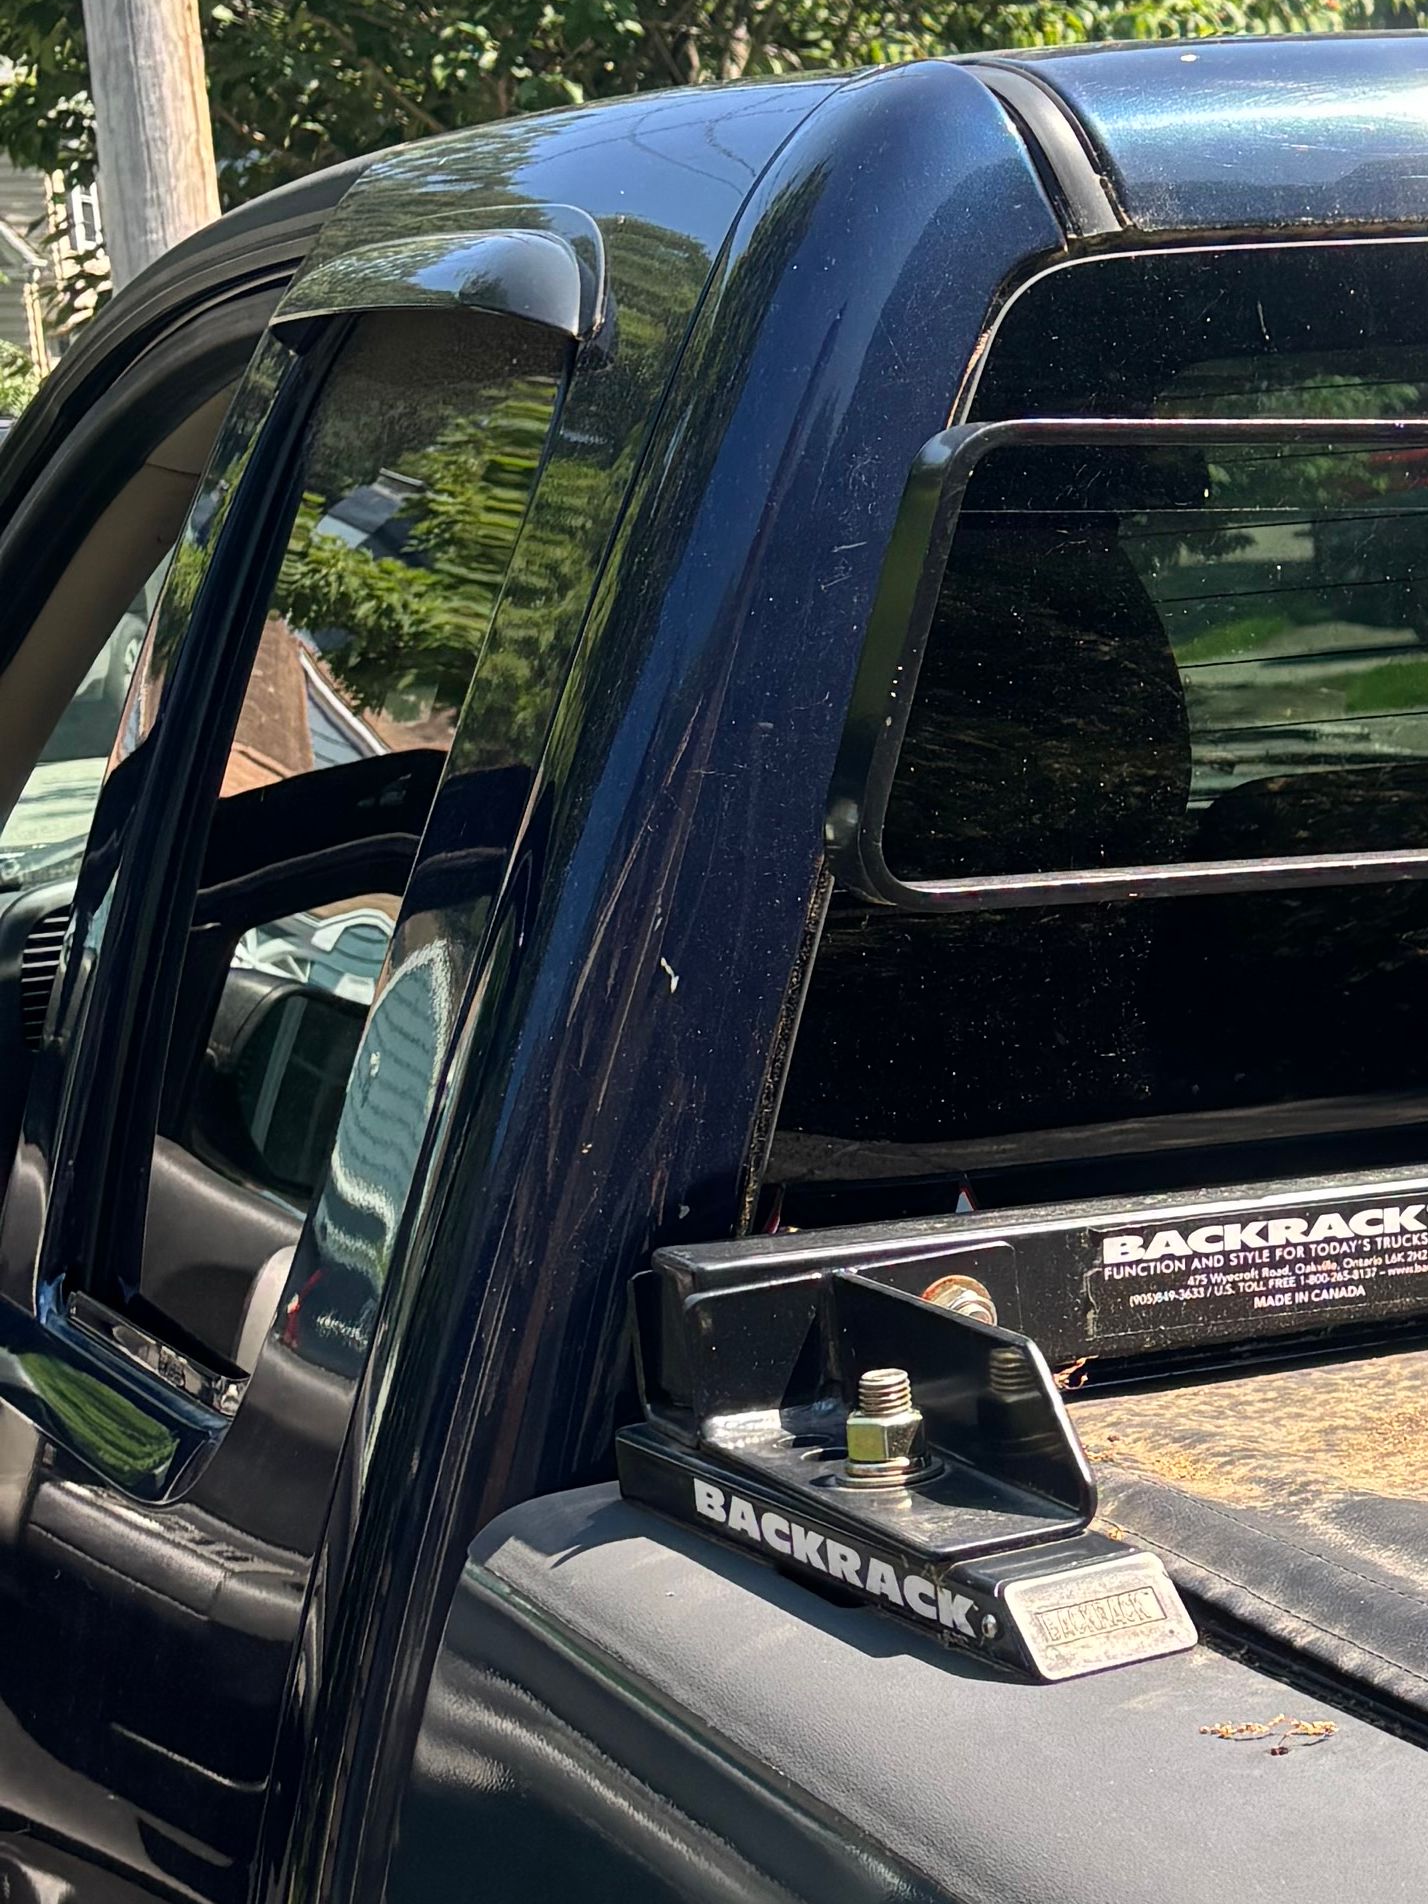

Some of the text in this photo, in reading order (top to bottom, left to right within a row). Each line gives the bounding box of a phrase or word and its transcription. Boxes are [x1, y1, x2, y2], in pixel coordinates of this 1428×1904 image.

[1102, 1203, 1428, 1265] BACKRACK
[1104, 1232, 1428, 1281] FUNCTION AND STYLE FOR TODAY'S TRUCKS
[1187, 1274, 1208, 1287] 475
[1343, 1255, 1383, 1269] Ontario
[1214, 1285, 1236, 1296] U.S.
[1237, 1281, 1267, 1294] TOLL
[1268, 1276, 1297, 1290] FREE
[1253, 1285, 1366, 1309] MADE IN CANADA
[692, 1477, 978, 1639] BACKRACK
